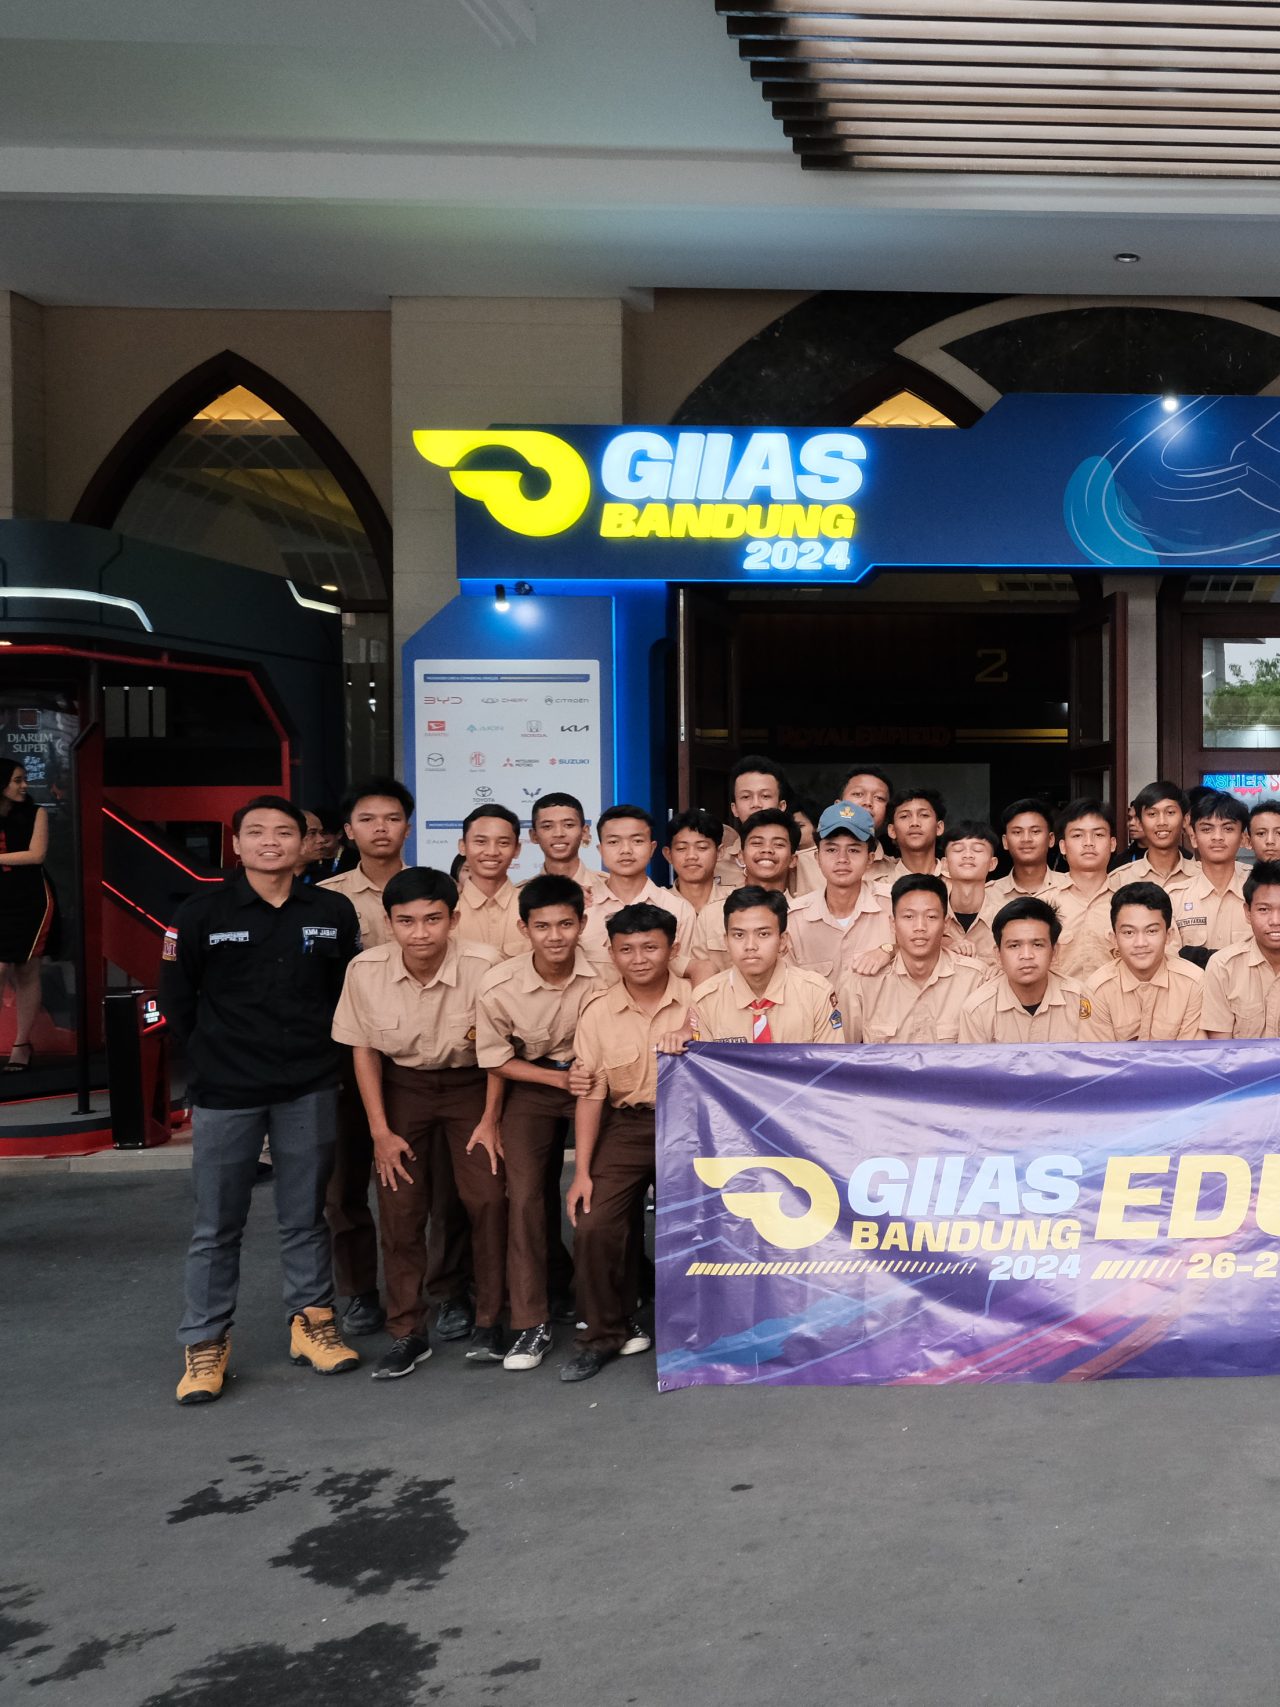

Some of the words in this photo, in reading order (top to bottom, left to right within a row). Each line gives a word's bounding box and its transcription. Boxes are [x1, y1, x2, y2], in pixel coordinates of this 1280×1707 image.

[601, 431, 867, 500] GIIAS
[600, 503, 856, 538] BANDUNG
[743, 540, 850, 570] 2024
[424, 696, 463, 704] BYD
[7, 733, 53, 743] DJARUM
[13, 744, 48, 753] SUPER
[847, 1155, 1083, 1216] GIIAS
[849, 1219, 1081, 1252] BANDUNG
[988, 1254, 1081, 1280] 2024
